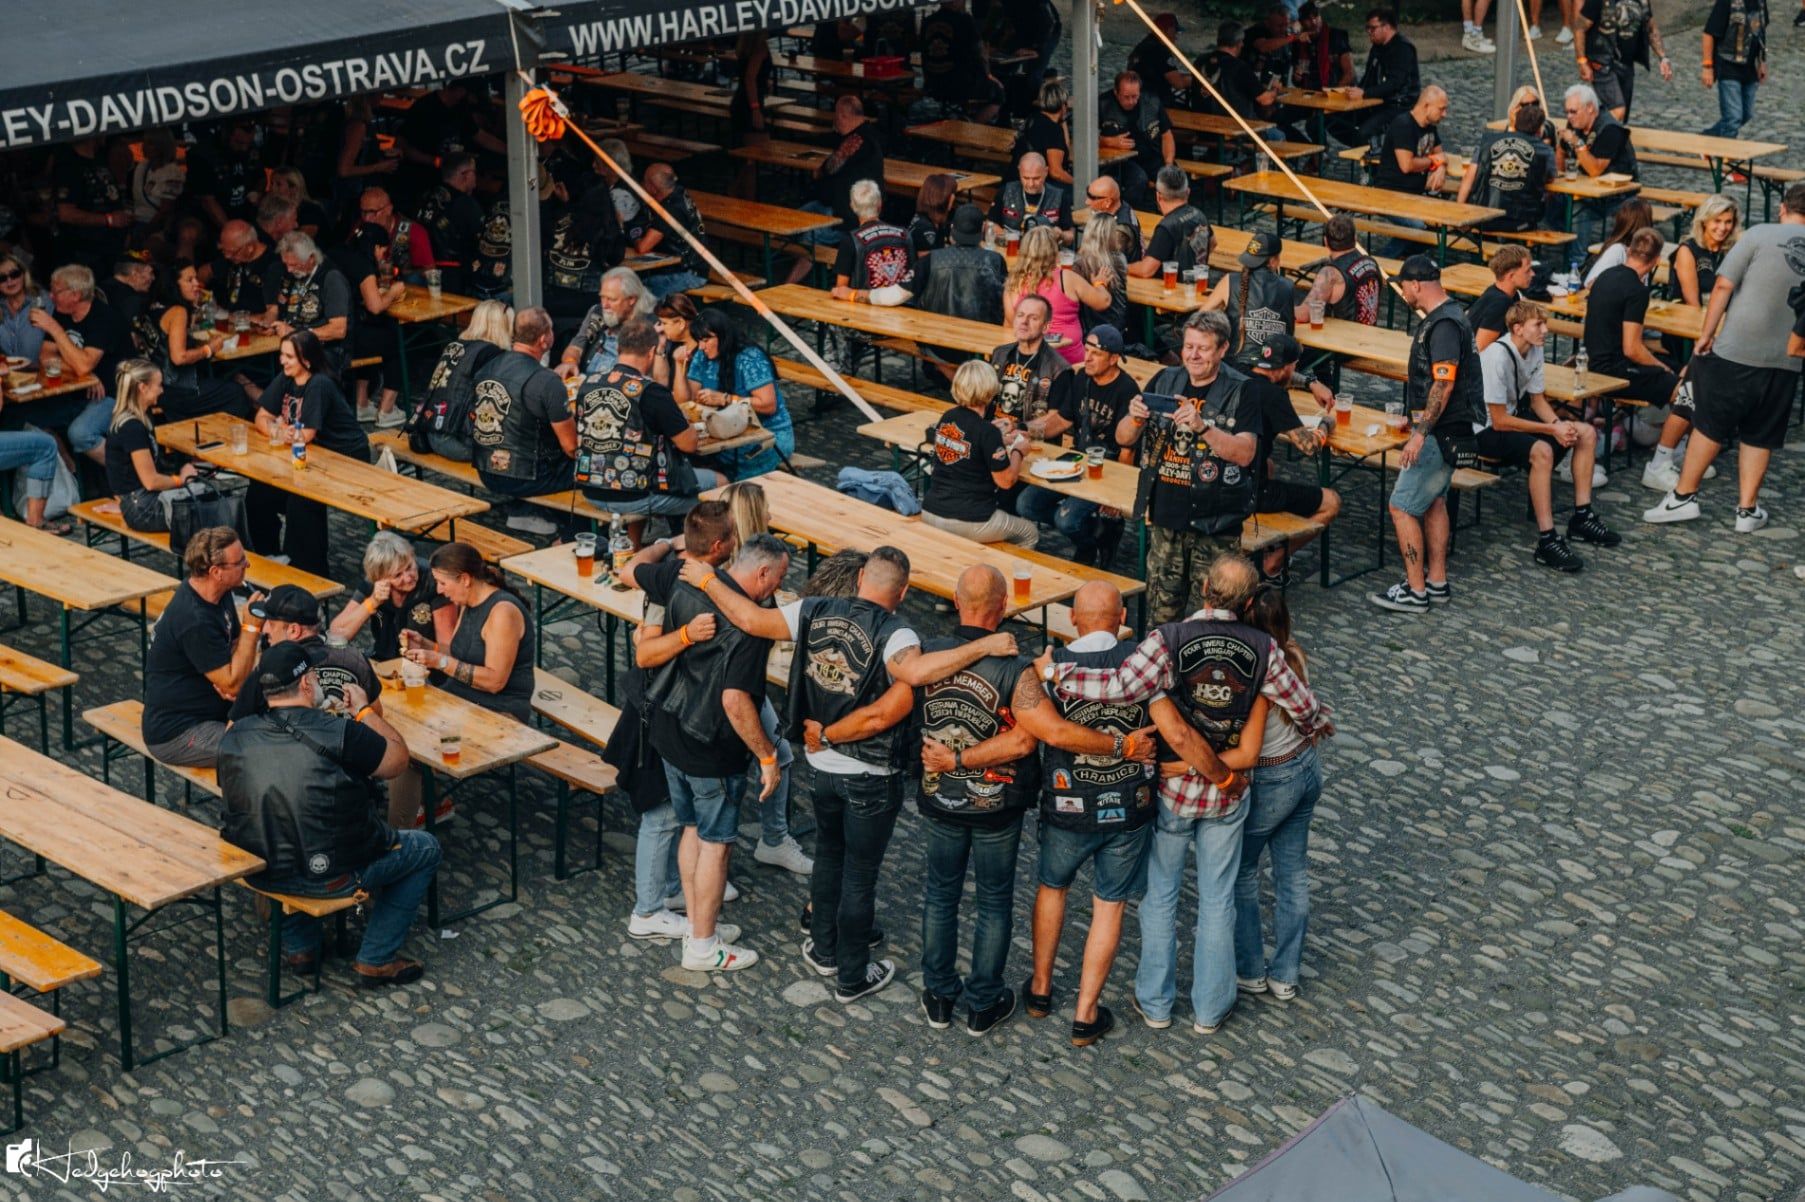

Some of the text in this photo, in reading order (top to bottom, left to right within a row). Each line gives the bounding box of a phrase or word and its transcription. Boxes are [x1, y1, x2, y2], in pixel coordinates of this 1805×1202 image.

[0, 39, 490, 148] EY-DAVIDSON-OSTRAVA.CZ
[953, 674, 994, 703] MEMBER
[1080, 764, 1136, 783] HRANICE
